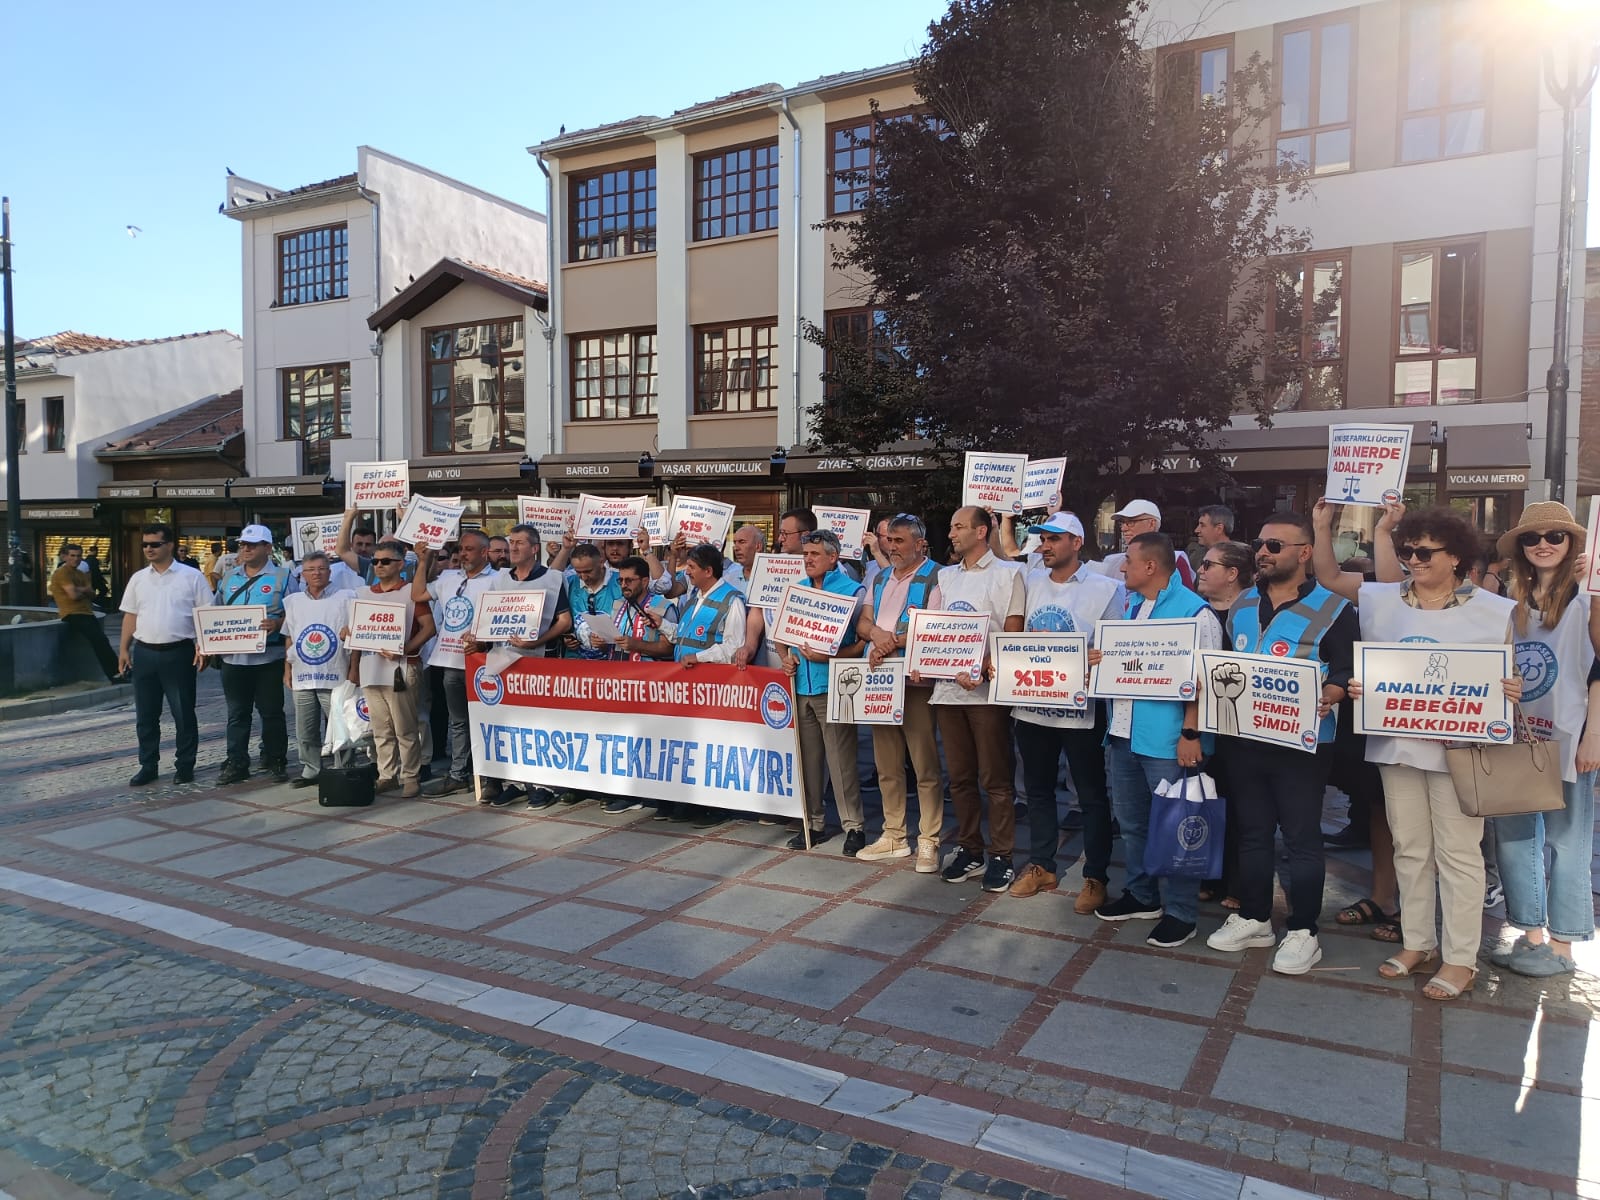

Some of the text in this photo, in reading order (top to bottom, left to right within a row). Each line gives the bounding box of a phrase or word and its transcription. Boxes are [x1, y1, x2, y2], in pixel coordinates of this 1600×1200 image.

[1375, 434, 1404, 444] ÜCRET
[1352, 446, 1402, 460] NERDE
[566, 466, 610, 475] BARGELLO
[661, 463, 762, 475] YAŞAR KUYUMCULUK
[974, 462, 1016, 473] GEÇİNMEK
[1333, 461, 1384, 474] ADALET?
[363, 469, 397, 480] EŞİT İŞE
[427, 469, 461, 479] AND YOU
[1450, 474, 1525, 484] VOLKAN METRO
[354, 479, 405, 490] EŞİT ÜCRET
[972, 474, 1013, 485] İSTİYORUZ,
[991, 485, 1020, 493] KALMAK
[355, 490, 405, 500] İSTİYORUZ!
[978, 492, 1003, 502] DEĞİL!
[617, 508, 638, 516] DEĞİL
[822, 512, 859, 520] ENFLASYON
[592, 518, 628, 526] MASA
[590, 527, 627, 535] VERSİN
[766, 567, 801, 575] YÜKSELTİN
[514, 604, 536, 612] DEĞİL
[789, 593, 849, 615] ENFLASYONU
[368, 613, 395, 623] 4688
[491, 614, 526, 624] MASA
[787, 615, 839, 635] MAAŞLARI
[925, 622, 979, 630] ENFLASYONA
[203, 627, 247, 635] ENFLASYON
[490, 627, 527, 635] VERSİN
[915, 631, 984, 643] YENİLEN DEĞİL
[1002, 644, 1079, 653] AĞIR GELİR VERGİSİ
[1131, 640, 1145, 648] İÇİN
[921, 646, 974, 655] ENFLASYONU
[1118, 649, 1132, 657] İÇİN
[919, 657, 976, 667] YENEN ZAM!
[1147, 662, 1165, 671] BİLE
[1258, 667, 1300, 678] DERECEYE
[865, 674, 894, 685] 3600
[1144, 677, 1173, 685] ETMEZ!
[1251, 675, 1299, 694] 3600
[506, 673, 551, 697] GELİRDE
[553, 676, 594, 699] ADALET
[596, 678, 646, 702] ÜCRETTE
[649, 680, 689, 705] DENGE
[692, 683, 758, 711] İSTİYORUZ!
[1012, 690, 1069, 698] SABİTLENSİN!
[1375, 681, 1490, 697] ANALIK İZNİ
[865, 693, 893, 702] HEMEN
[1262, 692, 1300, 704] GÖSTERGE
[864, 703, 893, 716] ŞİMDİ!
[1252, 701, 1300, 717] HEMEN
[1385, 697, 1483, 715] BEBEĞİN
[1252, 715, 1300, 734] ŞİMDİ!
[1382, 716, 1486, 734] HAKKIDIR!
[480, 722, 793, 797] YETERSİZ TEKLİFE HAYIR!
